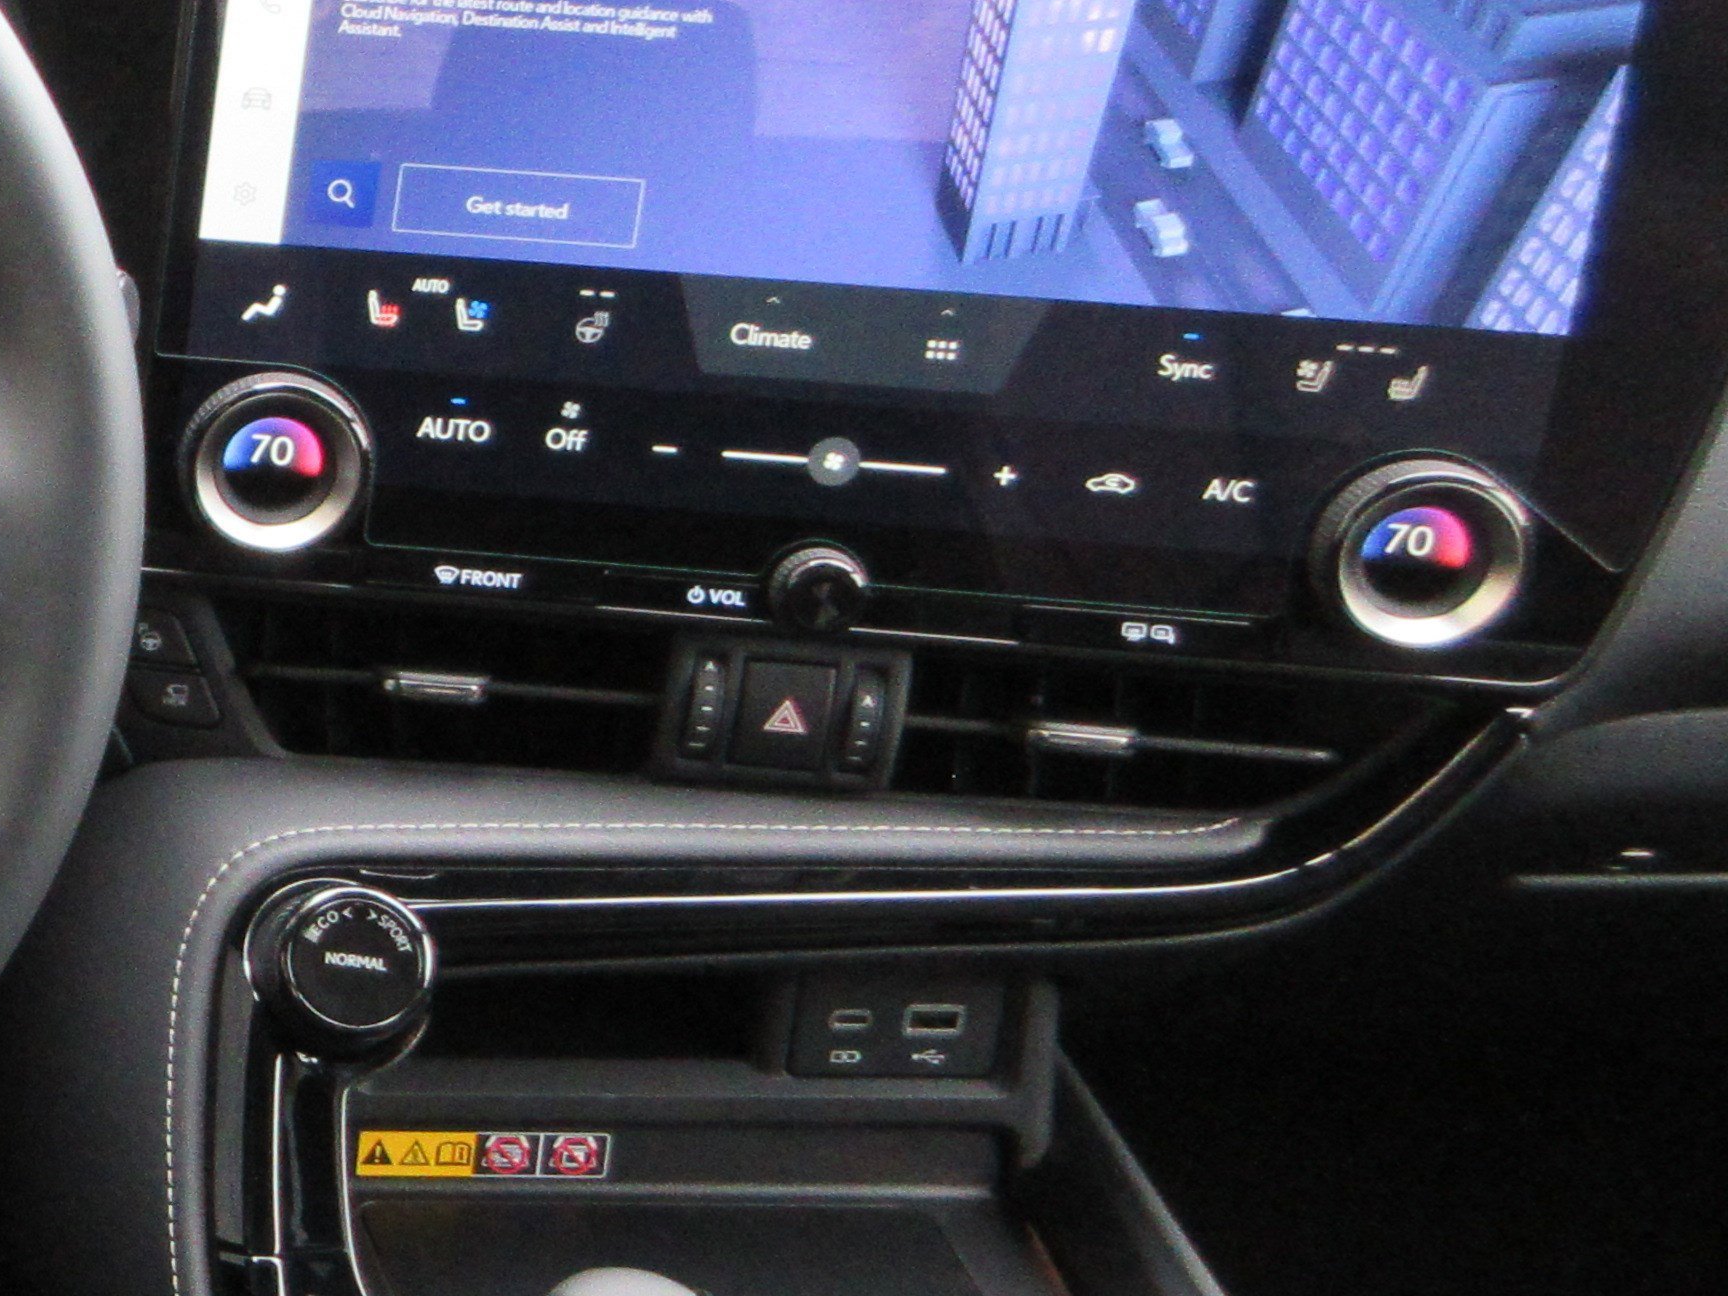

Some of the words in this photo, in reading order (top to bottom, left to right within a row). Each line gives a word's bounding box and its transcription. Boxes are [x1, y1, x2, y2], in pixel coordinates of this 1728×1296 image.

[339, 3, 382, 21] Cloud
[462, 11, 539, 30] Destination
[542, 15, 582, 32] Assist
[582, 17, 609, 34] and
[609, 18, 678, 41] Intelligent
[495, 0, 533, 14] route
[536, 0, 562, 16] and
[563, 0, 616, 19] location
[617, 4, 678, 24] guidance
[680, 7, 714, 24] with
[465, 194, 501, 219] Get
[505, 197, 570, 221] started
[411, 277, 450, 294] AUTO
[729, 322, 813, 351] Climate
[1157, 353, 1214, 384] Sync
[416, 416, 492, 444] AUTO
[544, 426, 589, 453] Off
[247, 432, 296, 469] 70
[1201, 477, 1256, 504] A/C
[1384, 520, 1435, 557] 70
[459, 567, 522, 589] FRONT
[708, 588, 747, 607] VOL
[304, 910, 340, 944] ECO
[377, 913, 413, 953] SPORT
[324, 950, 388, 972] NORMAL
